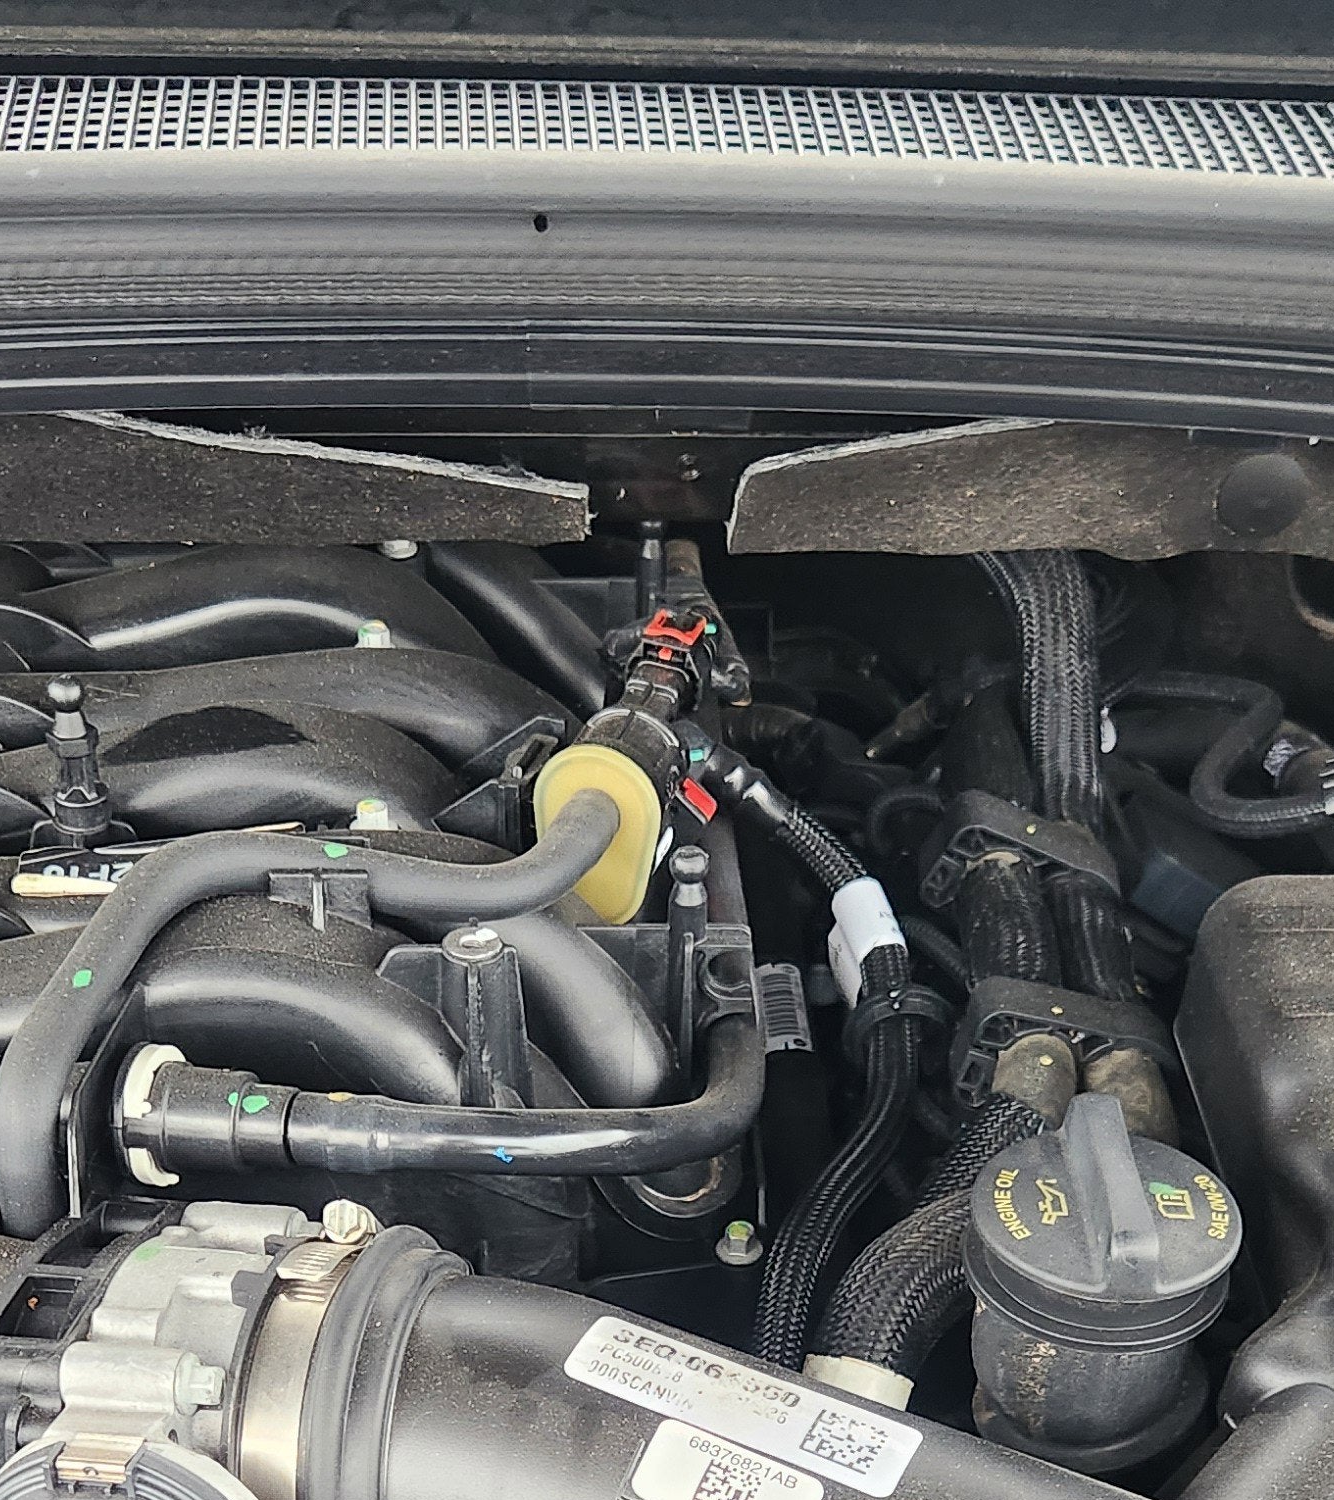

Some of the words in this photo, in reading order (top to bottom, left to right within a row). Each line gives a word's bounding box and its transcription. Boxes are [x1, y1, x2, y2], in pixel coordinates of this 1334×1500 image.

[995, 1168, 1019, 1189] OIL
[994, 1190, 1033, 1240] ENGINE
[1207, 1212, 1229, 1240] SAE
[688, 1435, 799, 1489] 68376821AB
